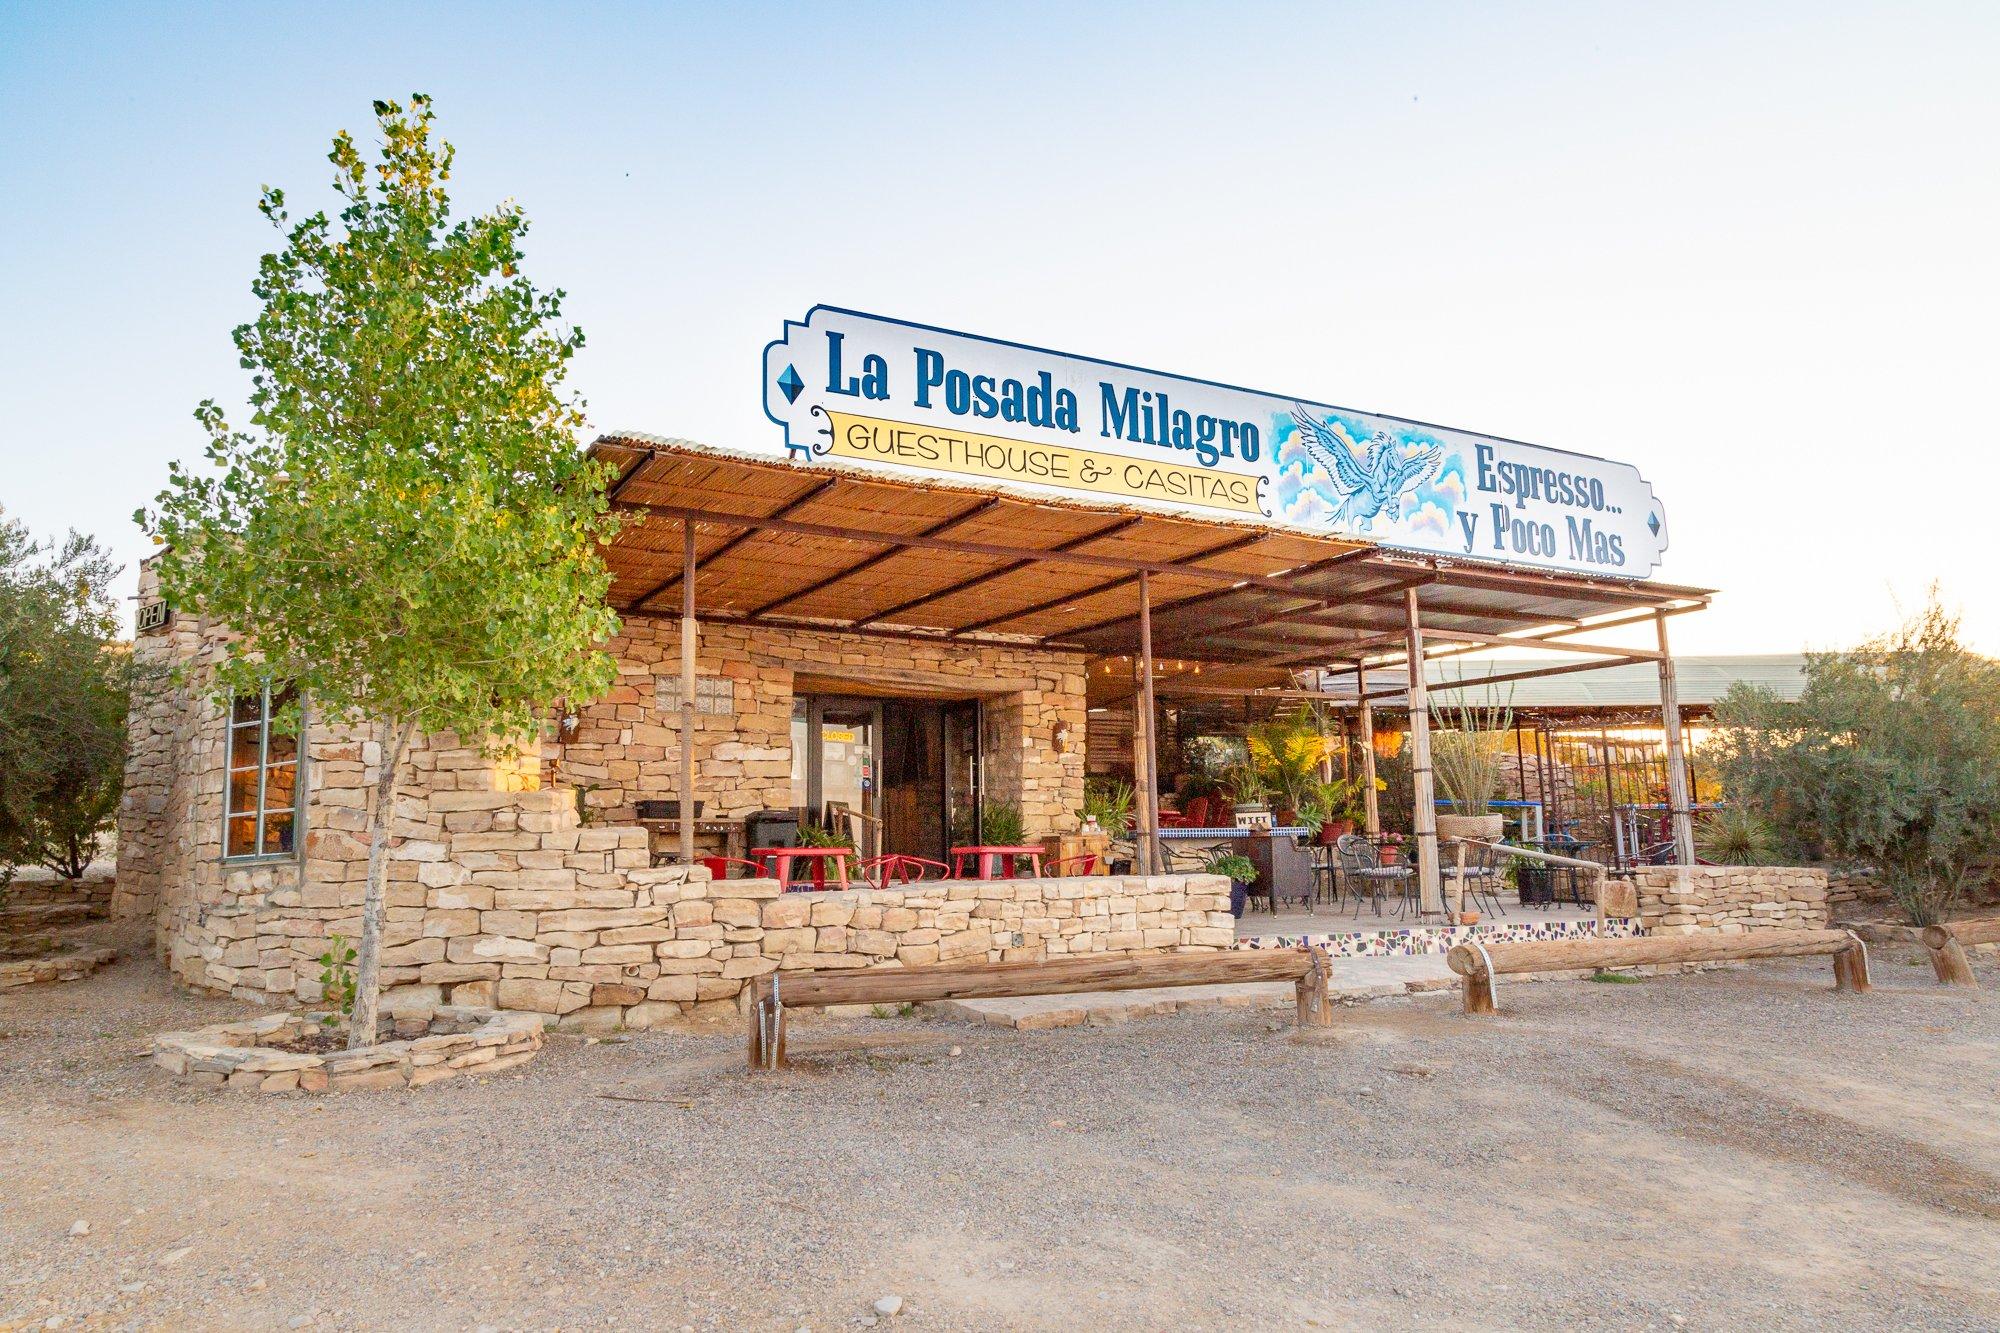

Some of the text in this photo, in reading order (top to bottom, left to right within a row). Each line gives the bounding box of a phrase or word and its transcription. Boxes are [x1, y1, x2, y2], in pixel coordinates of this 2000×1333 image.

[826, 330, 1260, 467] La Posada Milagro
[846, 424, 1249, 505] GUESTHOUSE & CASITAS
[1474, 443, 1622, 514] Espresso...
[1457, 503, 1625, 567] y Poco Mas
[138, 603, 164, 628] OPEN
[822, 731, 854, 742] CLOSED
